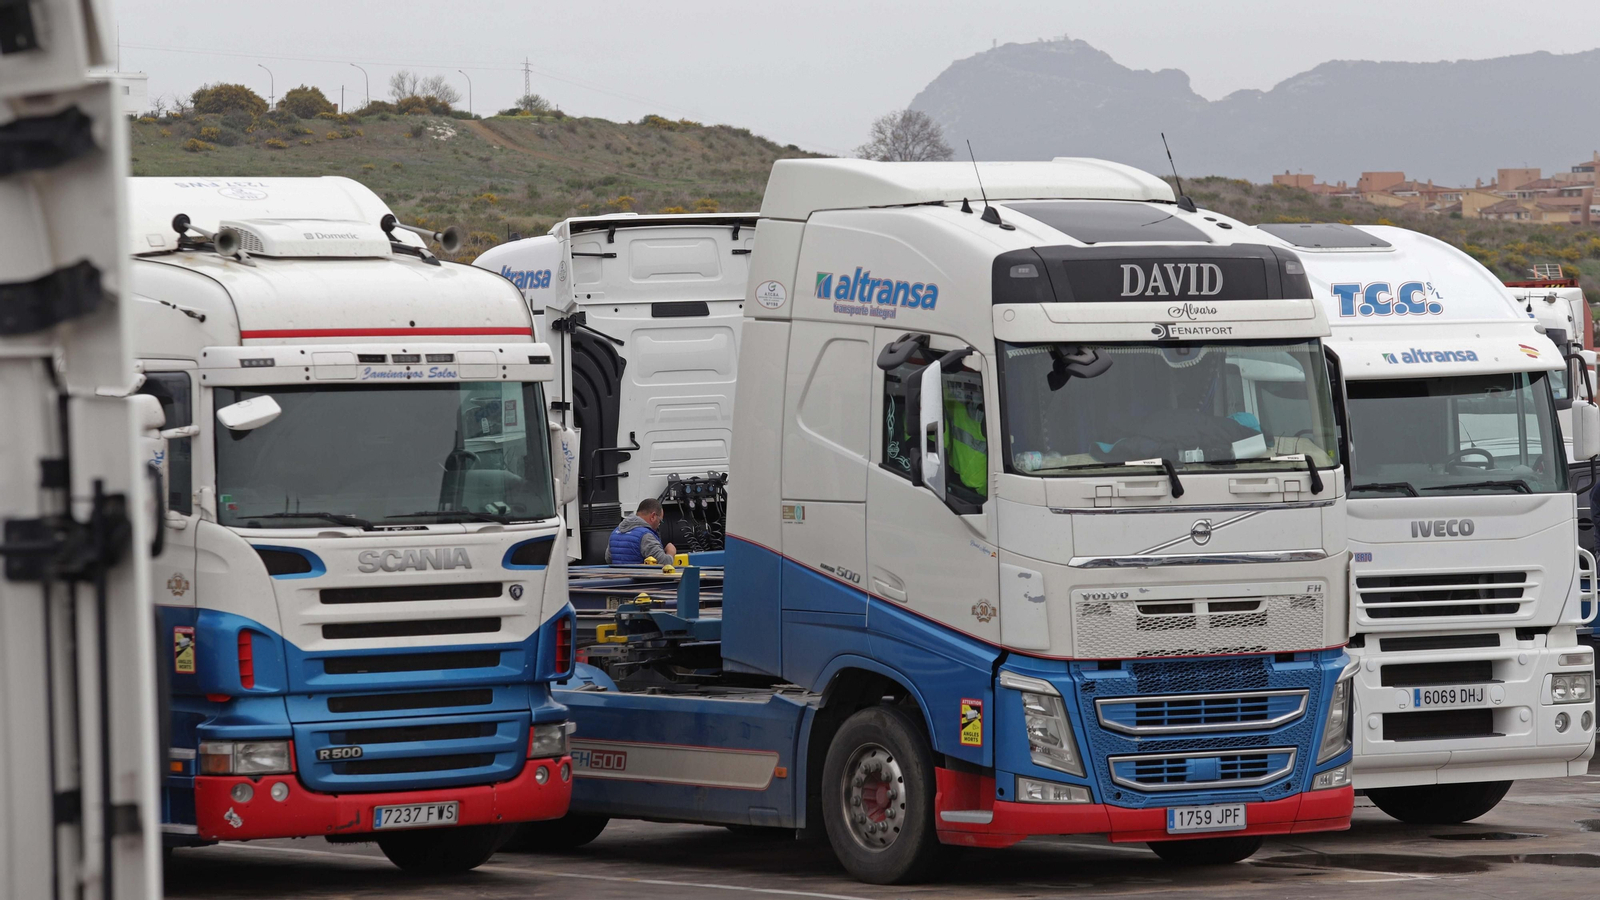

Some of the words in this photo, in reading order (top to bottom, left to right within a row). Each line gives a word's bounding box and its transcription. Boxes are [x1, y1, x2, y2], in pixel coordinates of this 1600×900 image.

[314, 232, 359, 240] Dometic
[500, 265, 552, 289] ltransa
[1120, 263, 1224, 297] DAVID
[834, 266, 940, 311] altransa
[1331, 281, 1444, 317] T.C.C.
[833, 301, 869, 317] transporte
[869, 305, 896, 320] integral
[1167, 303, 1218, 320] Alvaro
[1171, 326, 1233, 336] FENATPORT
[1401, 348, 1479, 364] altransa
[428, 366, 458, 379] Solos
[1411, 519, 1475, 539] IVECO
[358, 547, 472, 573] SCANIA
[836, 565, 861, 584] 500
[1081, 591, 1129, 601] VOLVO
[1306, 584, 1322, 593] FH
[980, 604, 989, 617] 30
[1424, 689, 1456, 705] 6069
[1460, 688, 1484, 703] DHJ
[320, 750, 330, 760] R
[332, 747, 362, 759] 500
[384, 807, 421, 824] 7237
[427, 805, 454, 822] FWS
[1179, 809, 1212, 827] 1759
[1217, 808, 1241, 824] JPF
